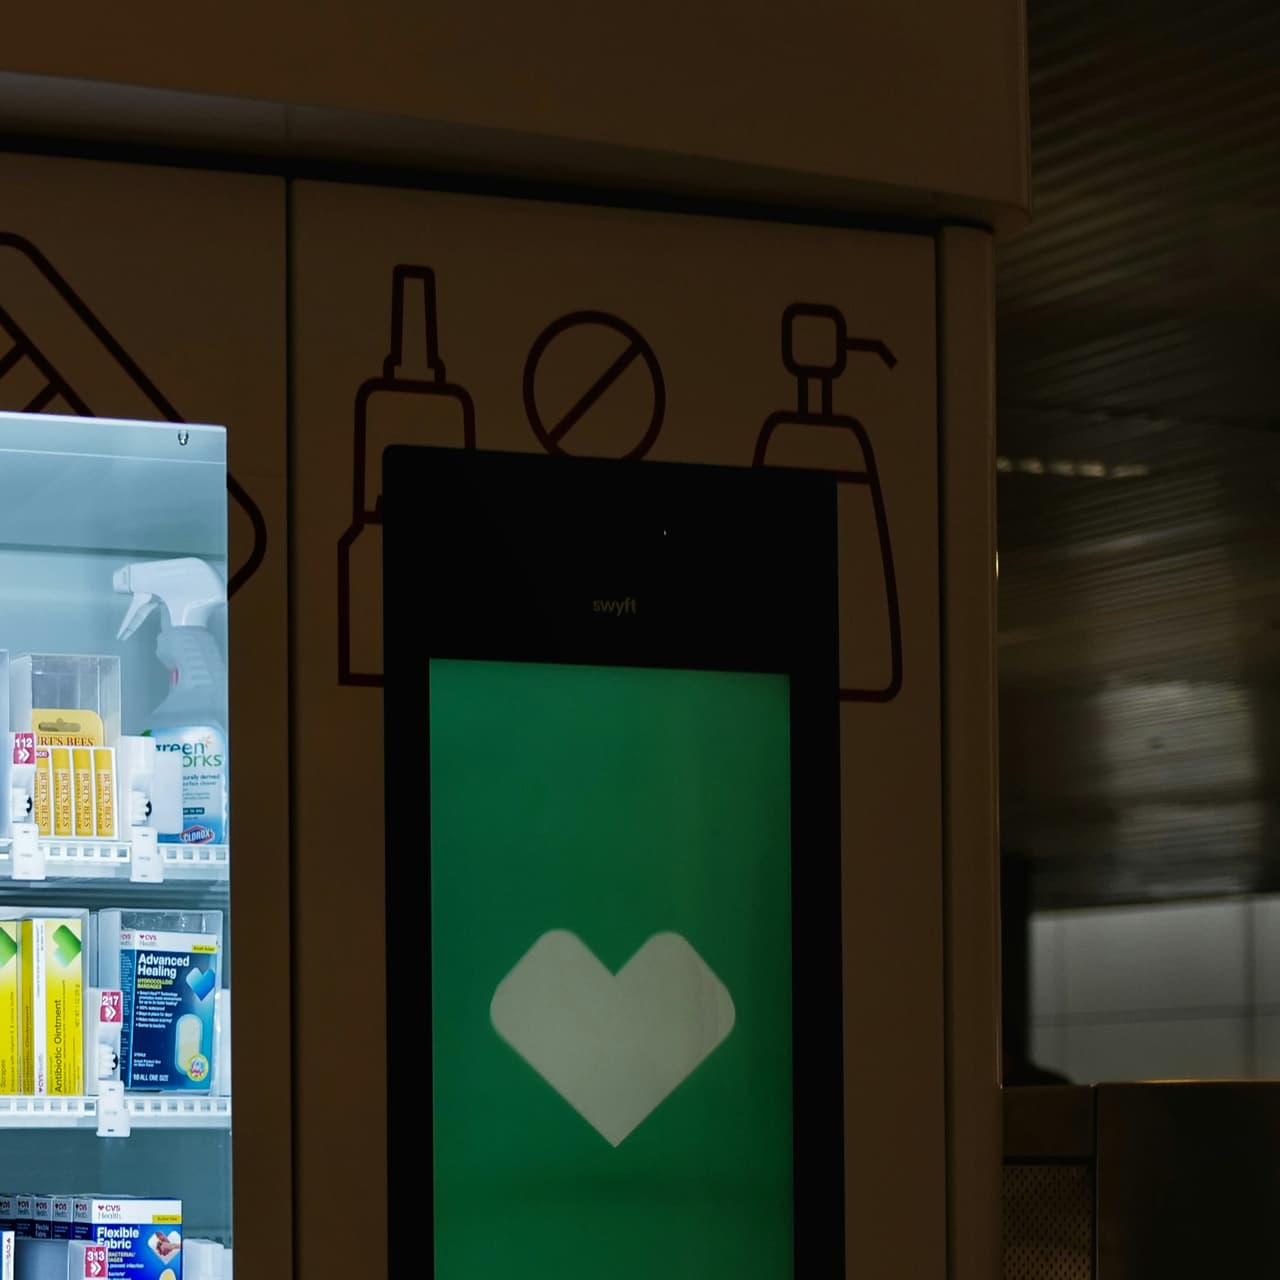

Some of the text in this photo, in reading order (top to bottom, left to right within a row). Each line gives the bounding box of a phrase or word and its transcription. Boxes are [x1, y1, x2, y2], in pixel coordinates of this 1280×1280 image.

[593, 597, 637, 615] swyft
[15, 738, 32, 748] 112
[138, 954, 190, 968] Advanced
[138, 966, 177, 979] Healing
[102, 996, 118, 1006] 217
[97, 1227, 139, 1238] Flexible
